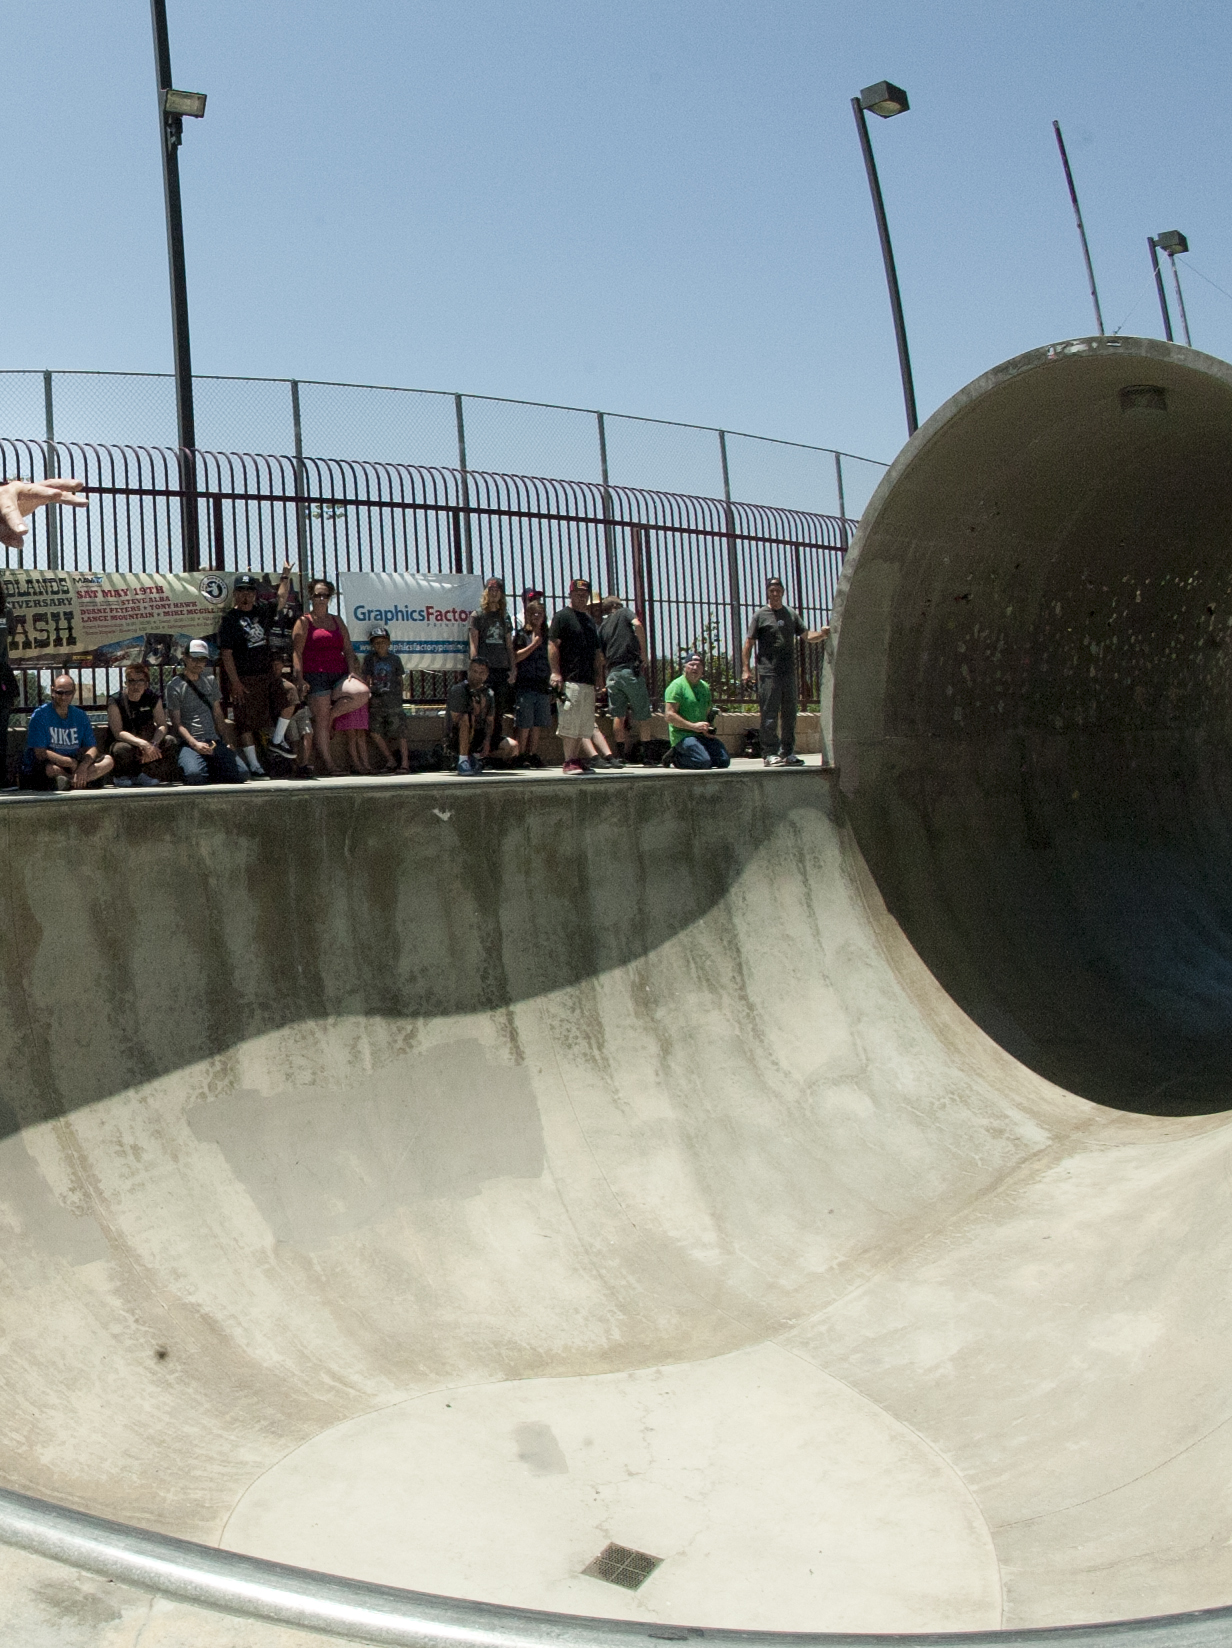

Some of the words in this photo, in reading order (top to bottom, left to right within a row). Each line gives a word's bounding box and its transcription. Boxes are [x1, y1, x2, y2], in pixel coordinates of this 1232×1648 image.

[76, 589, 99, 599] SAT
[101, 588, 129, 598] MAY
[133, 585, 165, 596] 19TH
[121, 598, 147, 606] STEVE
[149, 602, 172, 611] TONY
[81, 615, 109, 623] LANCE
[110, 612, 155, 621] MOUNTAIN
[353, 605, 472, 625] GraphicsFactor
[50, 726, 79, 746] NIKE
